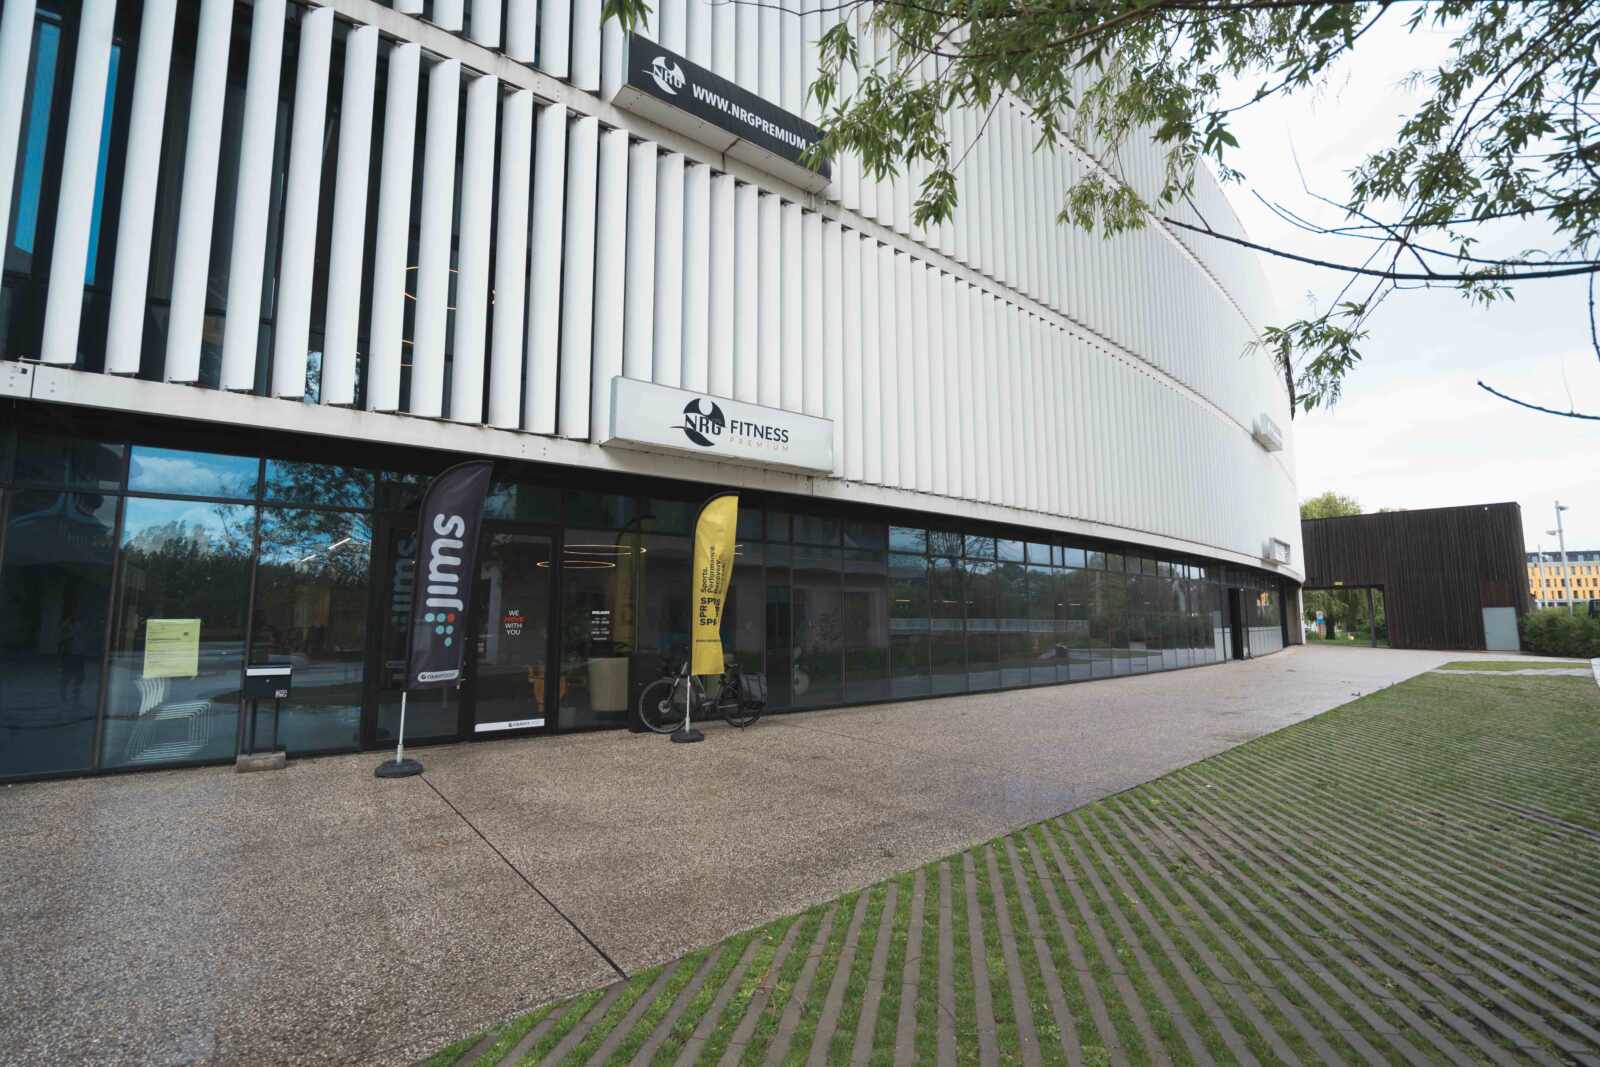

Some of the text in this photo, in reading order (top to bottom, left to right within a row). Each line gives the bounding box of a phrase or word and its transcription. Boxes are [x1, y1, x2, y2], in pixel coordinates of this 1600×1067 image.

[653, 64, 683, 89] NRG
[692, 83, 819, 155] WWW.NRGPREMIUM
[684, 414, 721, 436] NRG
[730, 419, 790, 444] FITNESS
